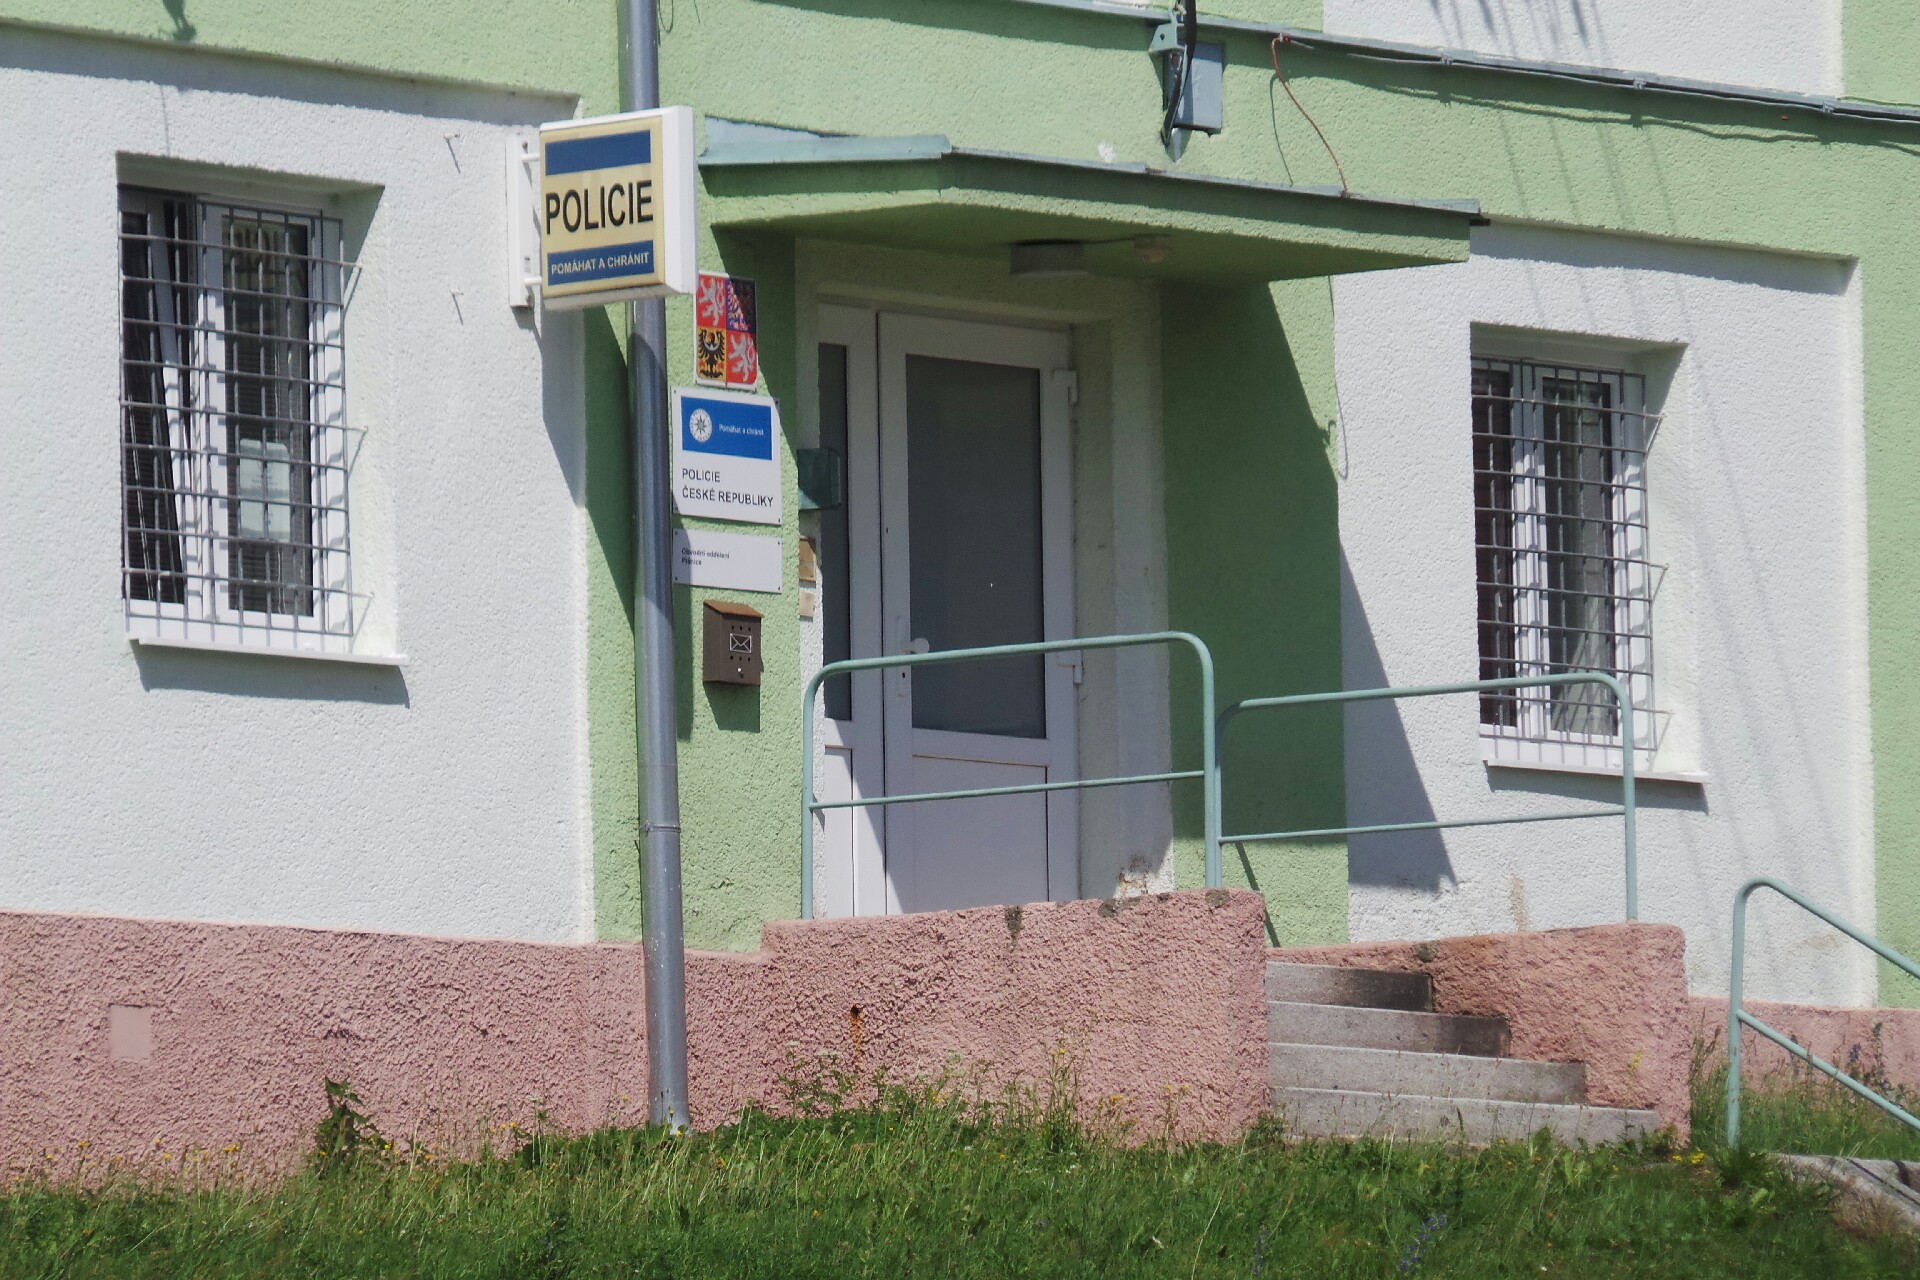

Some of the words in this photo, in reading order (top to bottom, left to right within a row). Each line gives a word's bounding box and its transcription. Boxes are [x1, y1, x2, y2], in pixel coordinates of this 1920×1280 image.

[545, 179, 654, 236] POLICIE
[551, 257, 597, 275] POMÁHAT
[599, 258, 606, 269] A
[607, 251, 650, 268] CHRÁNIT
[682, 467, 721, 483] POLICIE
[682, 484, 716, 502] ČESKÉ
[718, 490, 774, 508] REPUBLIKY
